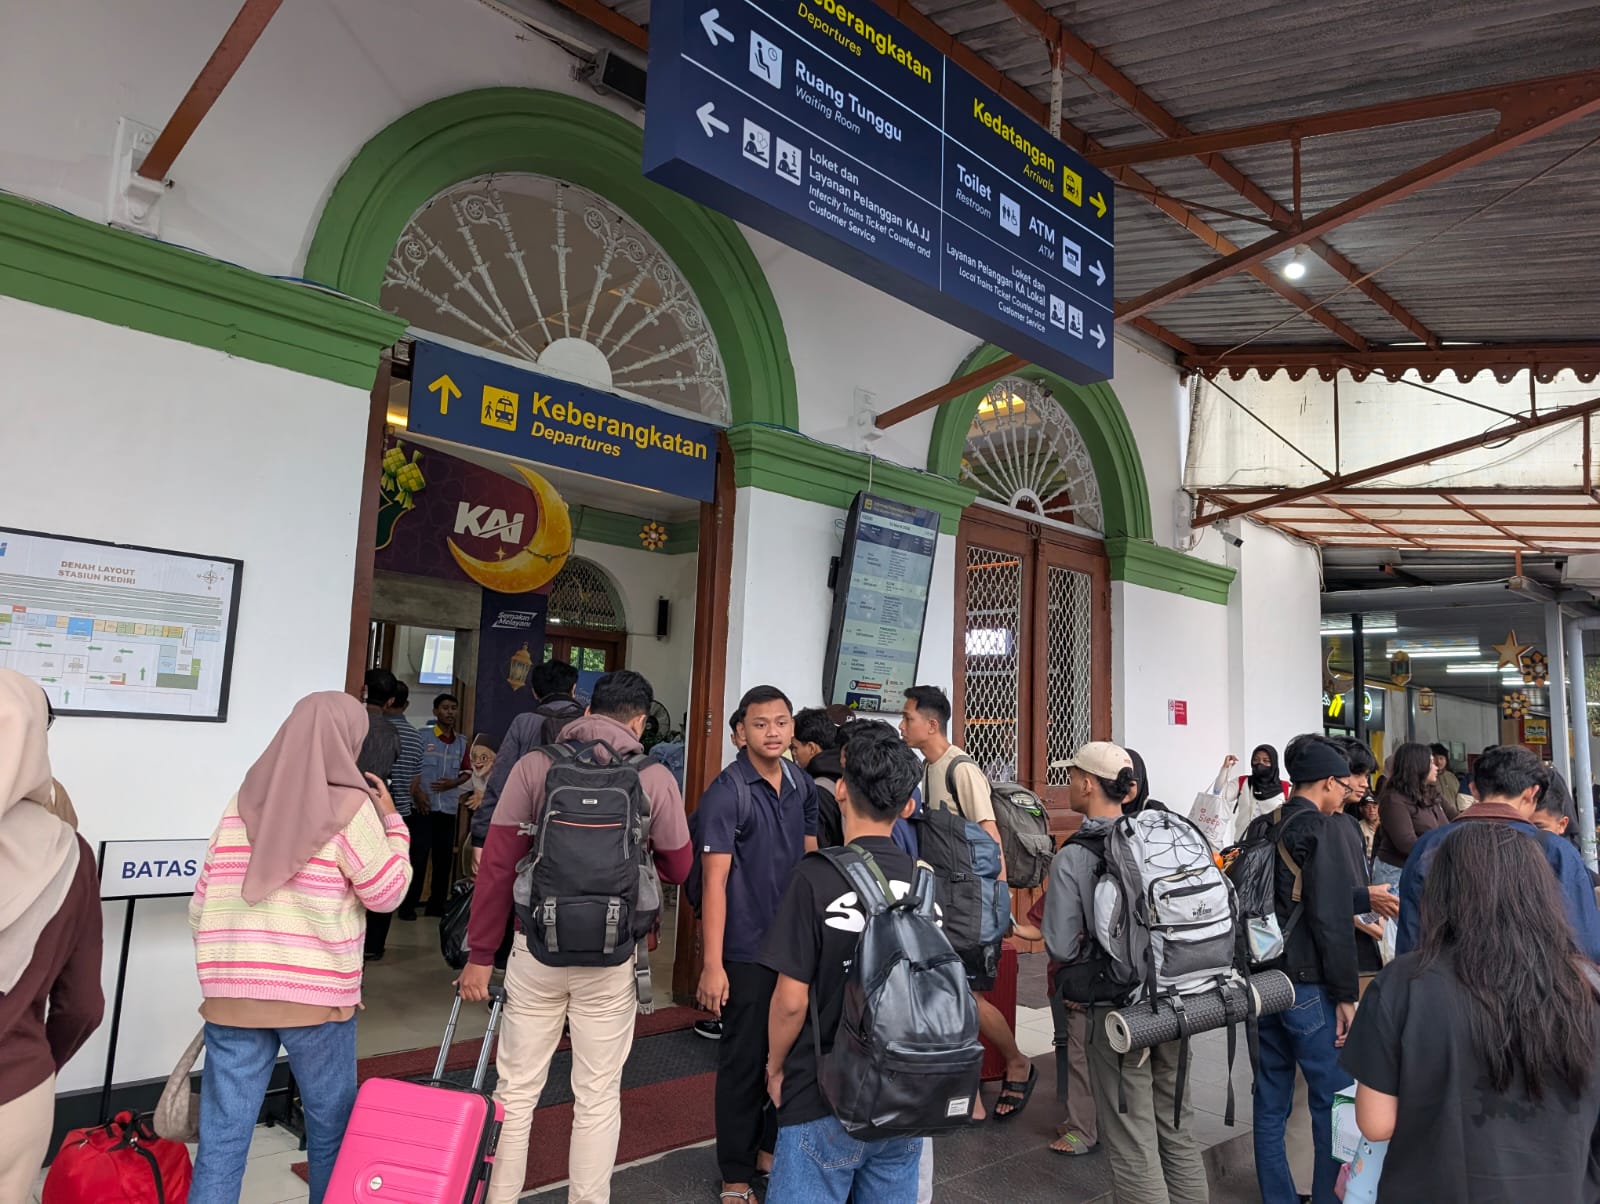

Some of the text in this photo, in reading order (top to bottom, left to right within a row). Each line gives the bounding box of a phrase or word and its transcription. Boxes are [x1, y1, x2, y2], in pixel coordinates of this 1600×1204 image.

[798, 2, 862, 57] Departures
[795, 59, 902, 142] Ruang Tunggu
[796, 84, 861, 135] Waiting Room
[972, 97, 1055, 174] Kedatangan
[809, 147, 859, 186] Loket dan
[1023, 163, 1055, 193] Arrivals
[808, 184, 931, 259] Intercity Trains Ticket Counter and
[808, 200, 876, 243] Customer Service
[809, 165, 851, 199] Layanan
[853, 190, 903, 228] Pelanggan
[956, 163, 1055, 245] Toilet ATM
[955, 188, 1055, 261] Restroom ATM
[946, 242, 1046, 307] Layanan Pelanggan KA Lokal
[959, 266, 1046, 321] Local Trains Ticket Counter and
[1011, 264, 1046, 293] Loket dan
[998, 301, 1046, 334] Customer Service
[530, 421, 622, 457] Departures
[531, 391, 708, 461] Keberangkatan
[453, 501, 525, 545] KAI
[58, 570, 136, 585] STASIUN KEDIRI
[61, 561, 136, 576] DENAH LAYOUT
[121, 859, 198, 880] BATAS
